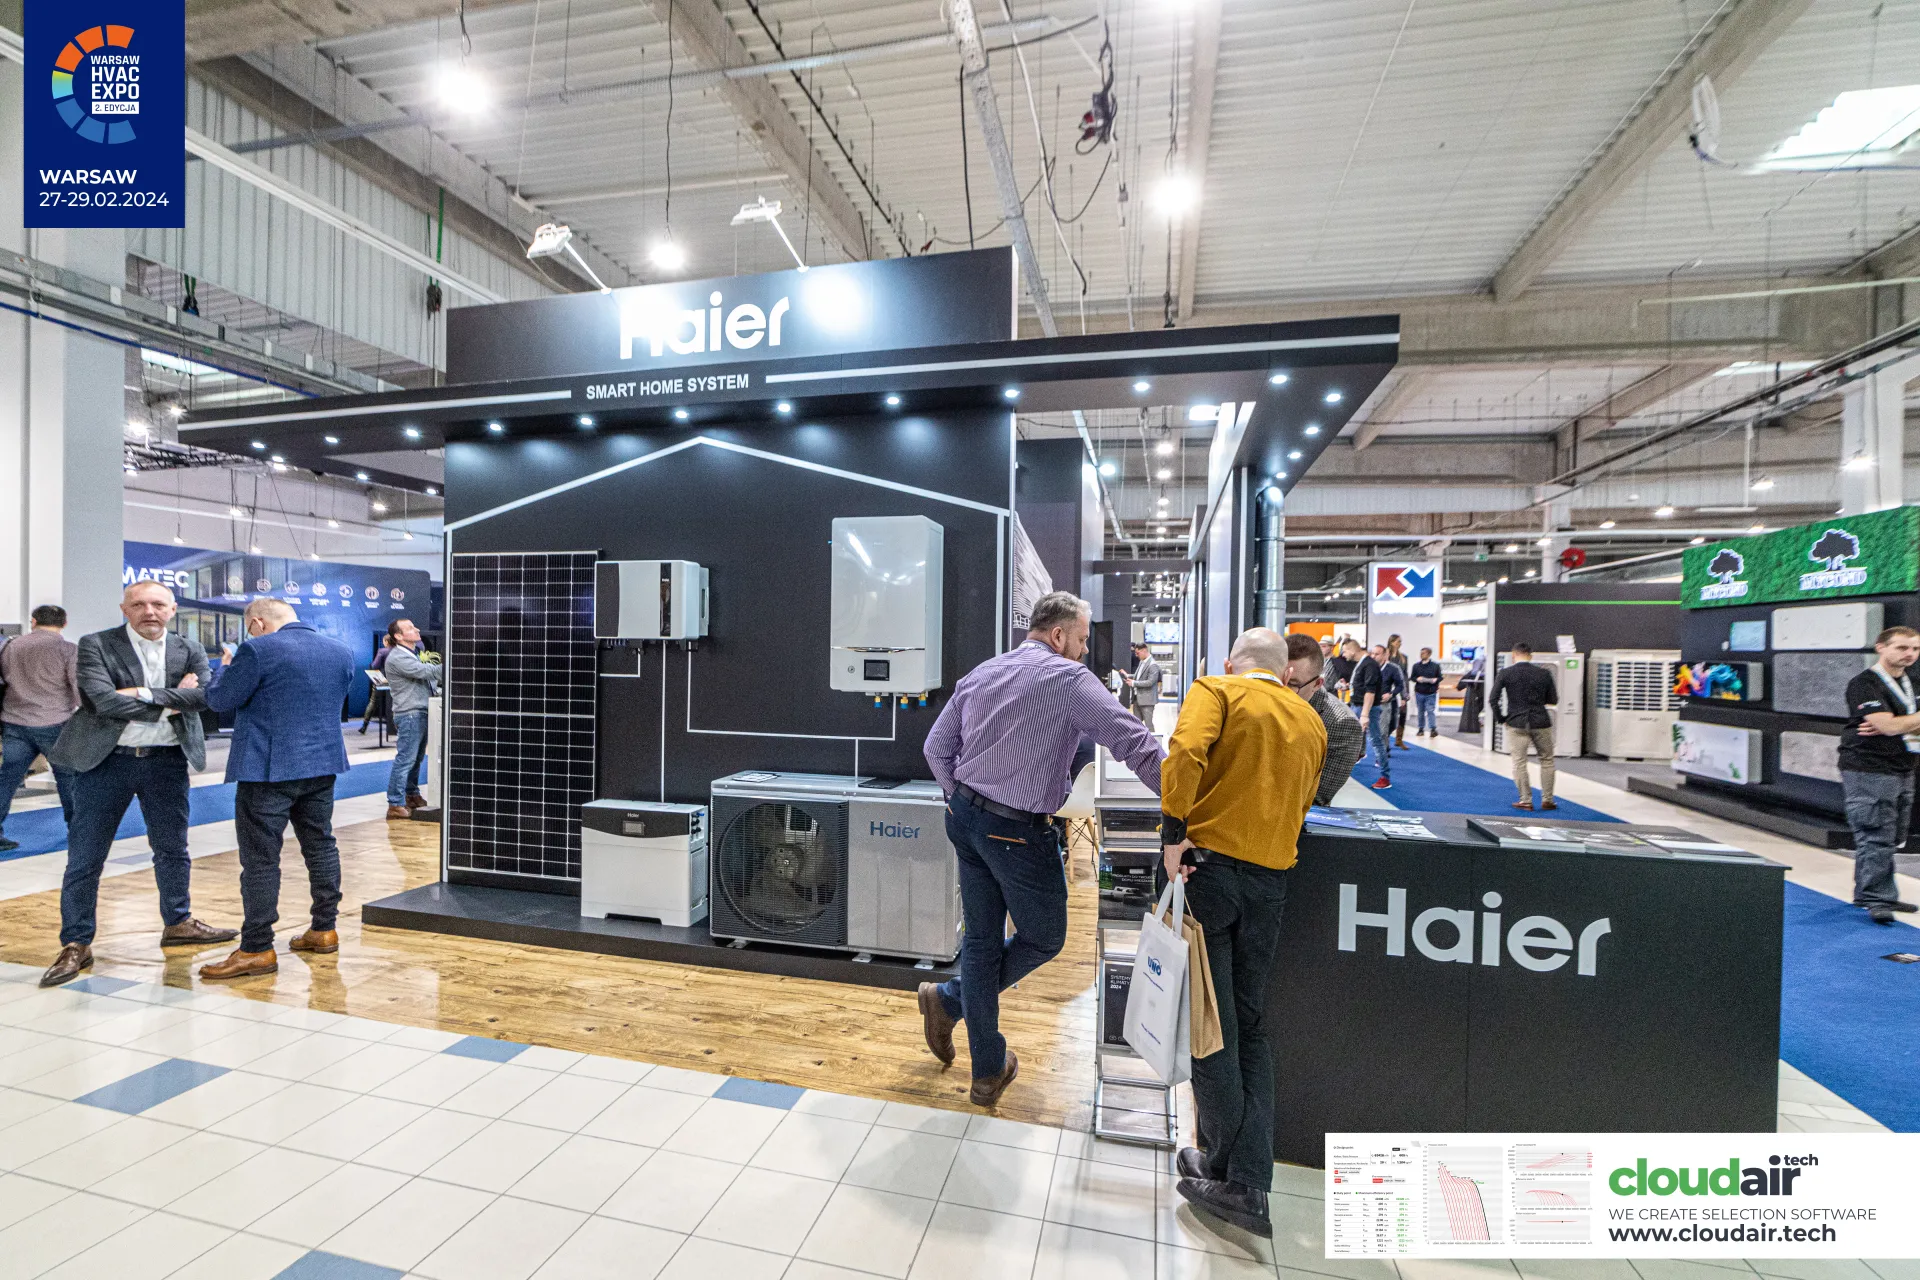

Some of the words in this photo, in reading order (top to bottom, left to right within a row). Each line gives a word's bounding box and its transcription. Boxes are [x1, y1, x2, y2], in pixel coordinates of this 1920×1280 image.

[586, 382, 637, 400] SMART
[640, 378, 684, 396] HOME
[687, 373, 749, 392] SYSTEM
[870, 819, 921, 839] Haier
[1337, 882, 1612, 977] Haier
